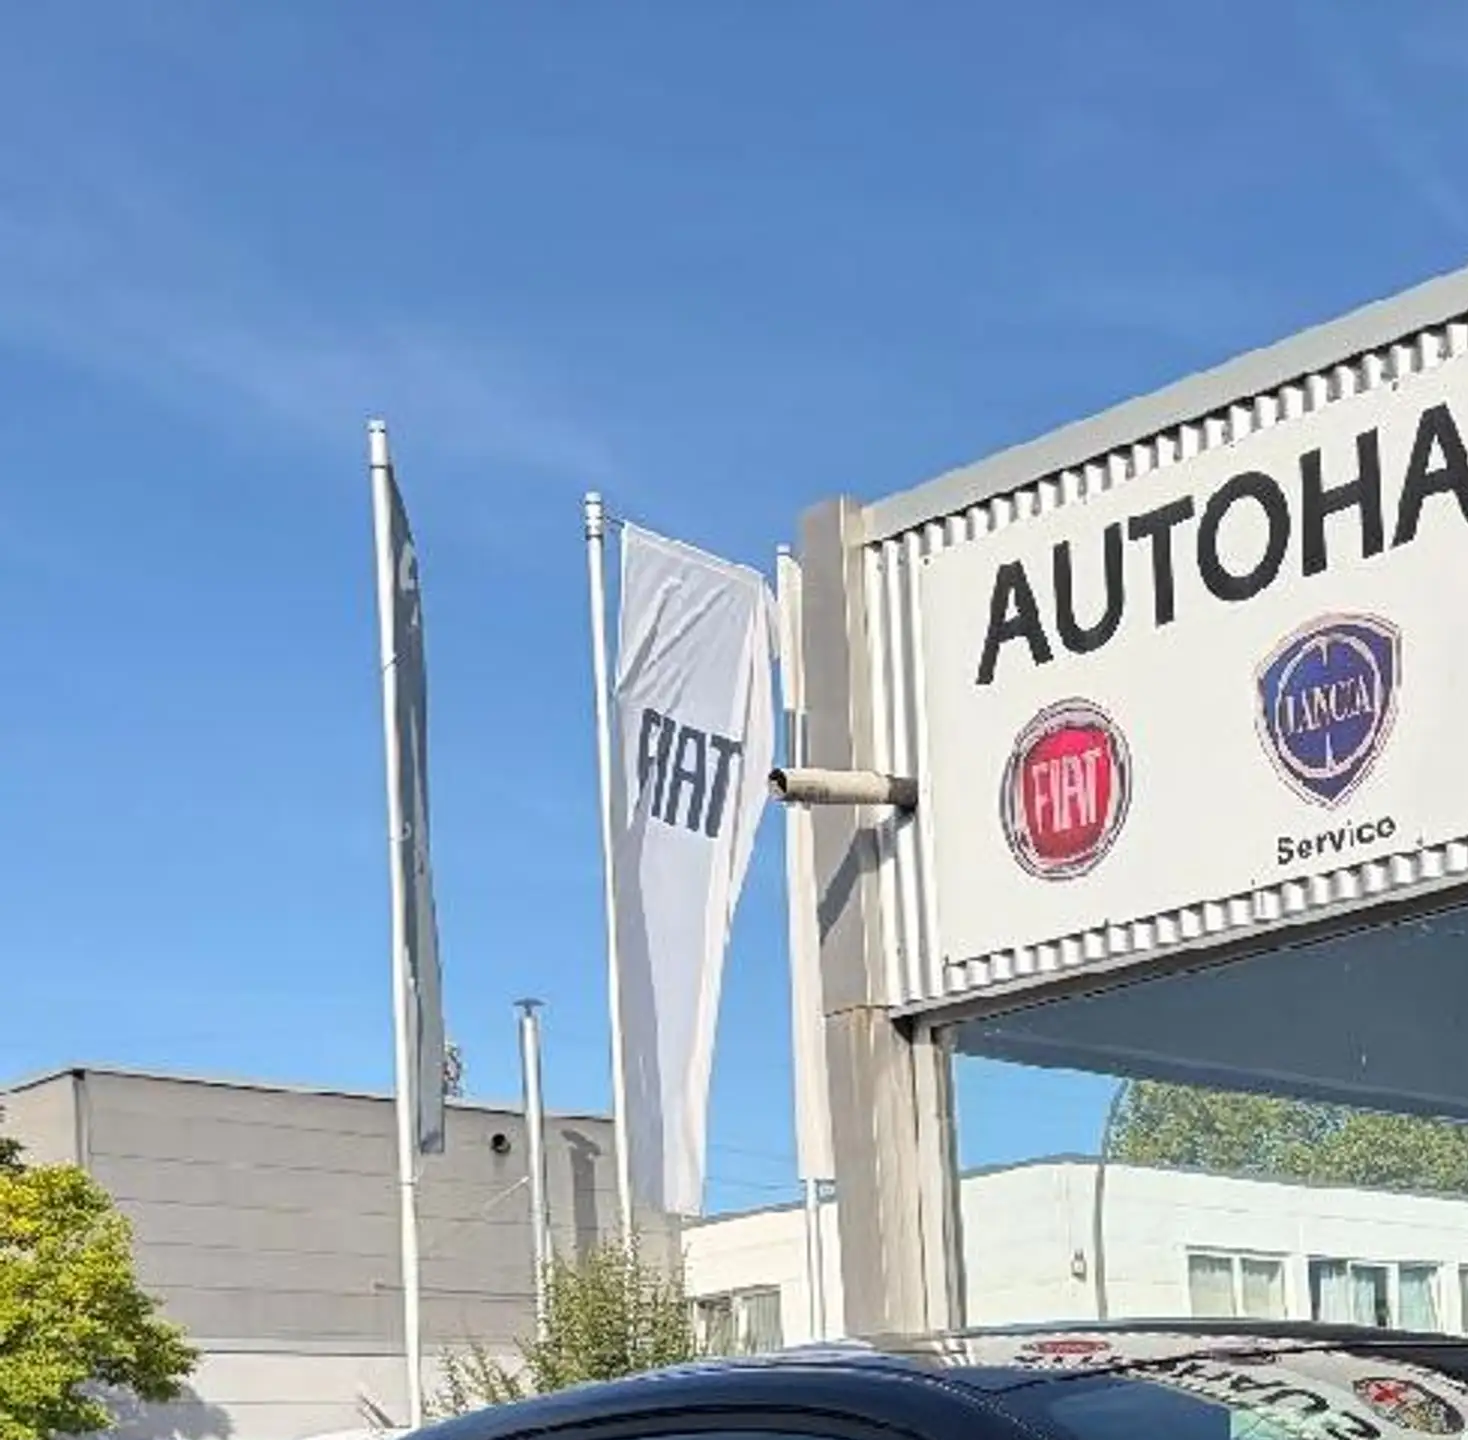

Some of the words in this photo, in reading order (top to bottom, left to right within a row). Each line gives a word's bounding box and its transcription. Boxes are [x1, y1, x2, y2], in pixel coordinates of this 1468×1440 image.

[1284, 674, 1373, 737] LANCIA
[637, 707, 743, 838] FIAT
[1032, 747, 1101, 834] FIAT
[1276, 815, 1397, 865] Service
